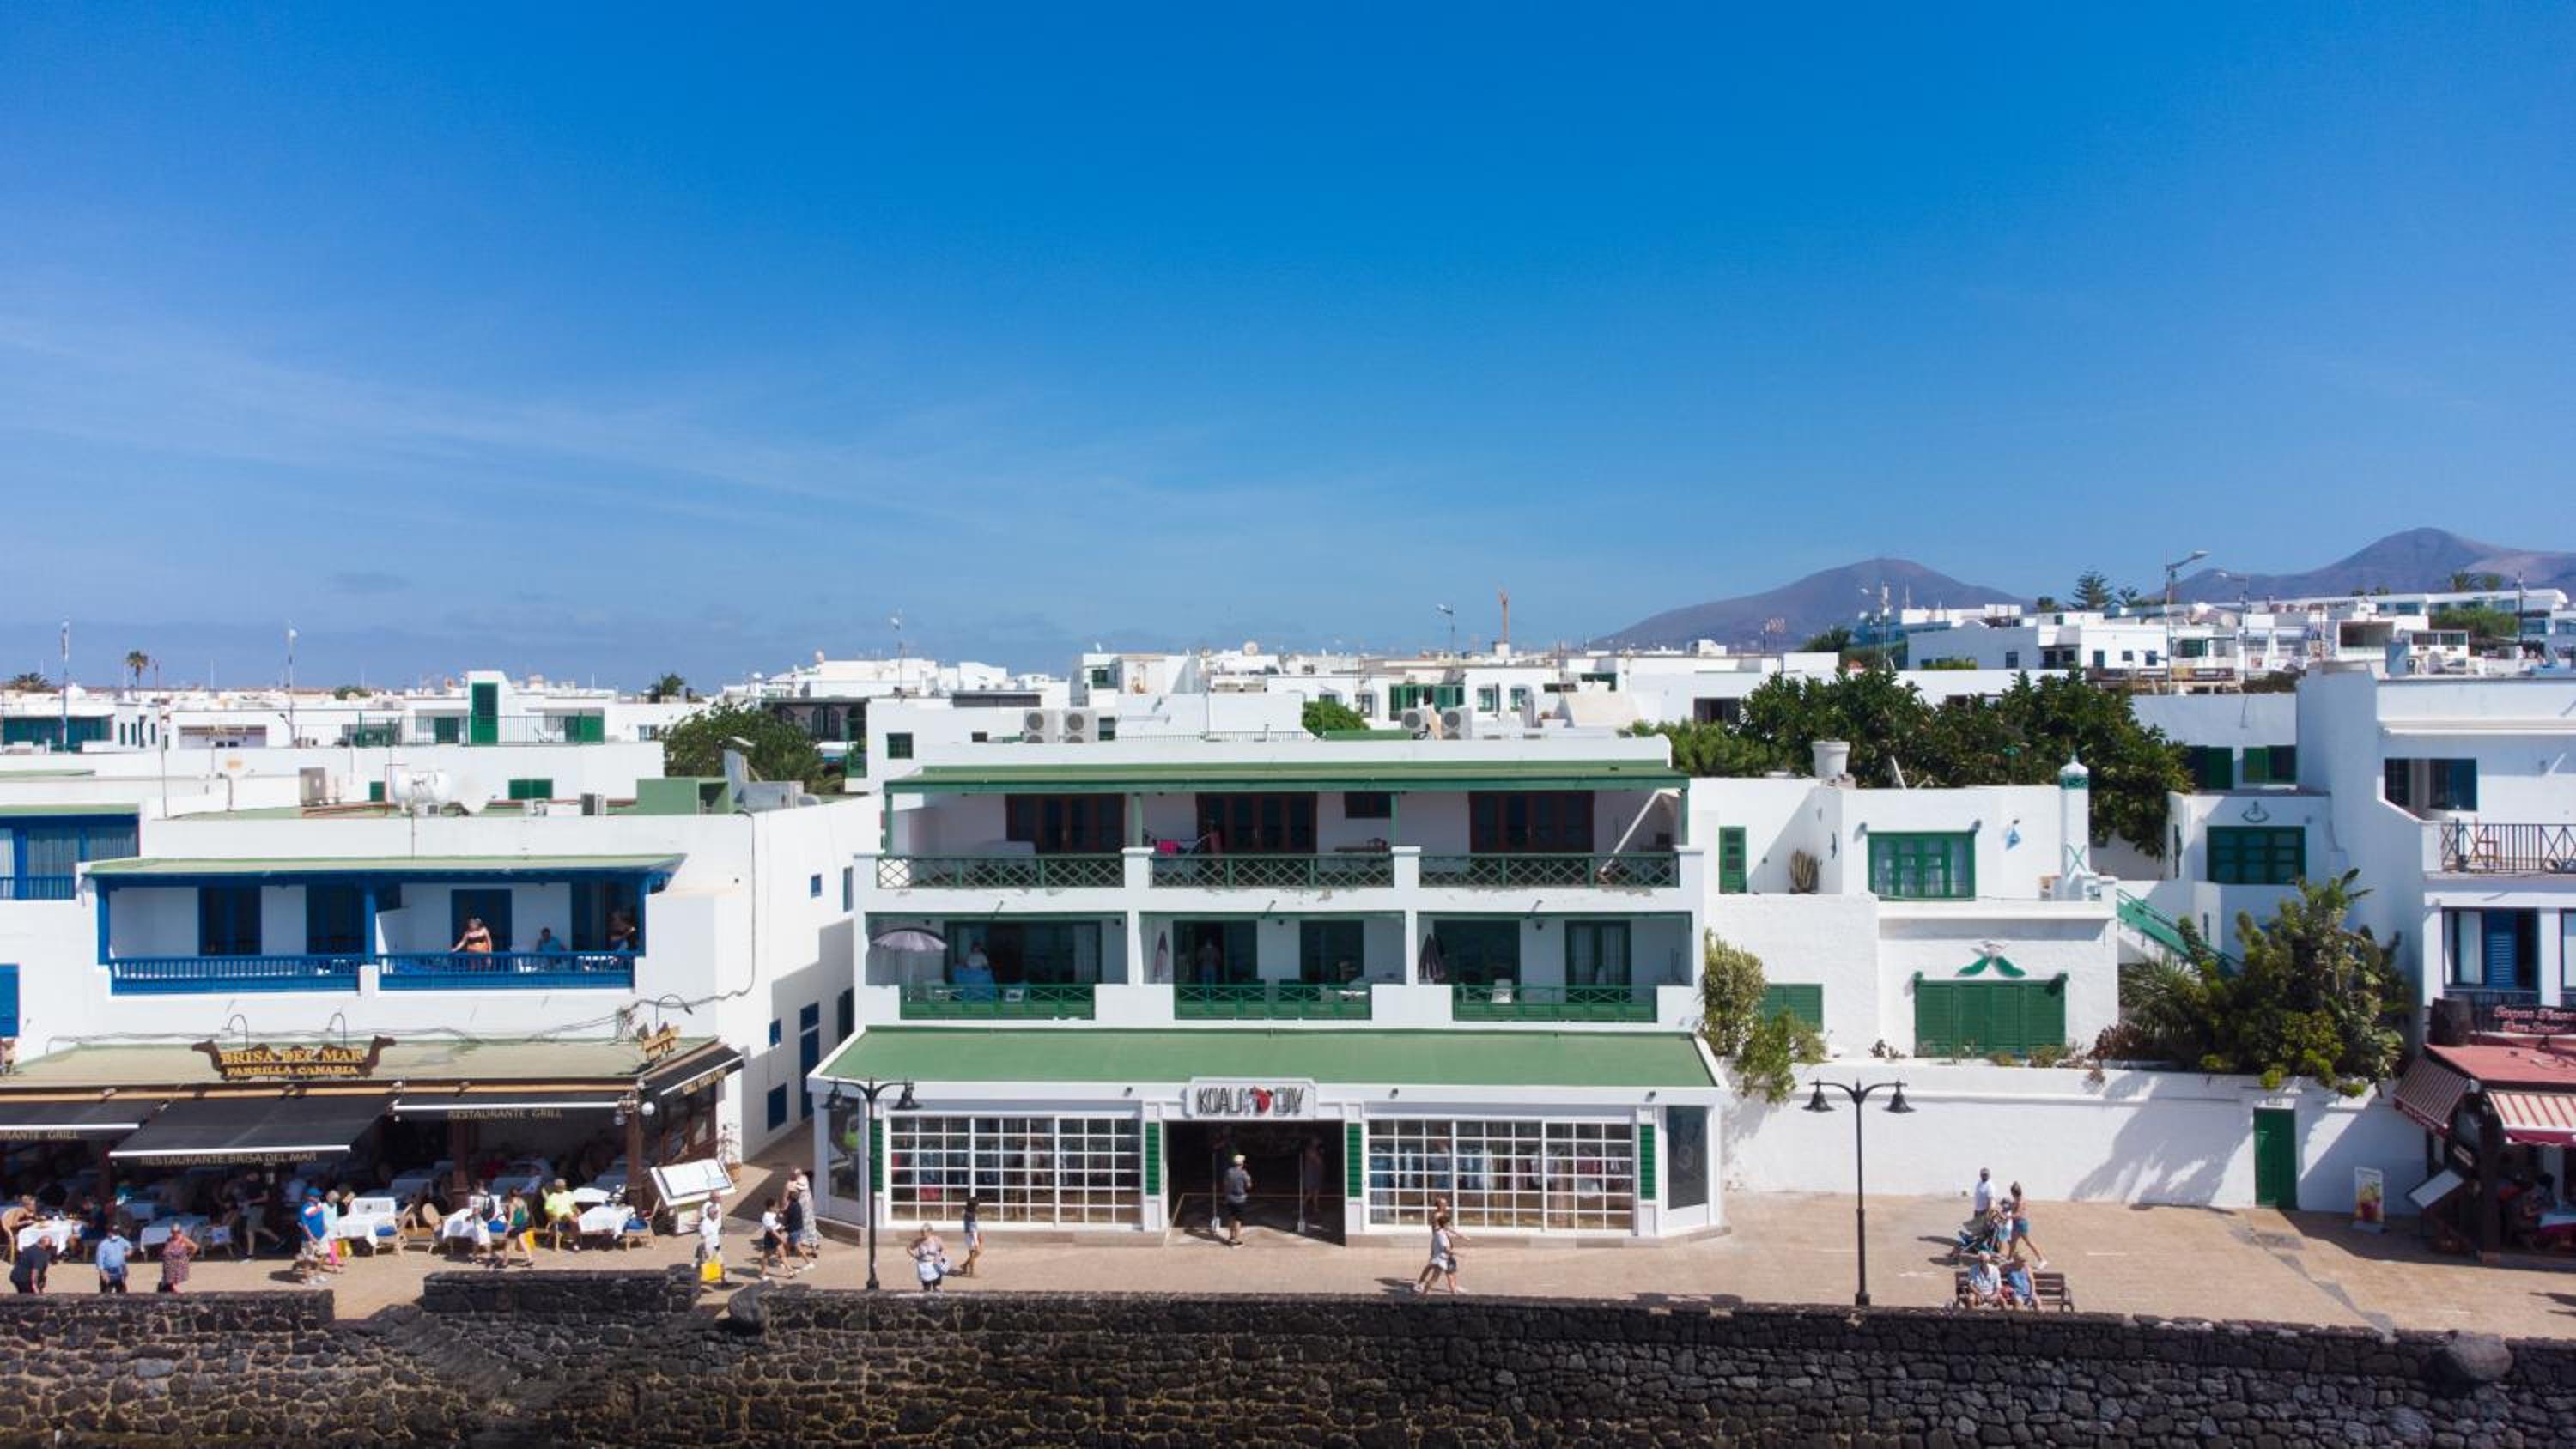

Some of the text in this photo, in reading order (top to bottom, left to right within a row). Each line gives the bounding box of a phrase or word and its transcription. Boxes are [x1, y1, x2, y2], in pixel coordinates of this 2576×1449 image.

[221, 1049, 362, 1064] BRISA DEL MAR
[227, 1065, 358, 1076] PARRILLA CANARIA
[447, 1108, 525, 1120] RESTAURANTE
[47, 1129, 79, 1140] GRILL
[140, 1151, 317, 1167] RESTAURANTE BRISA DEL MAR
